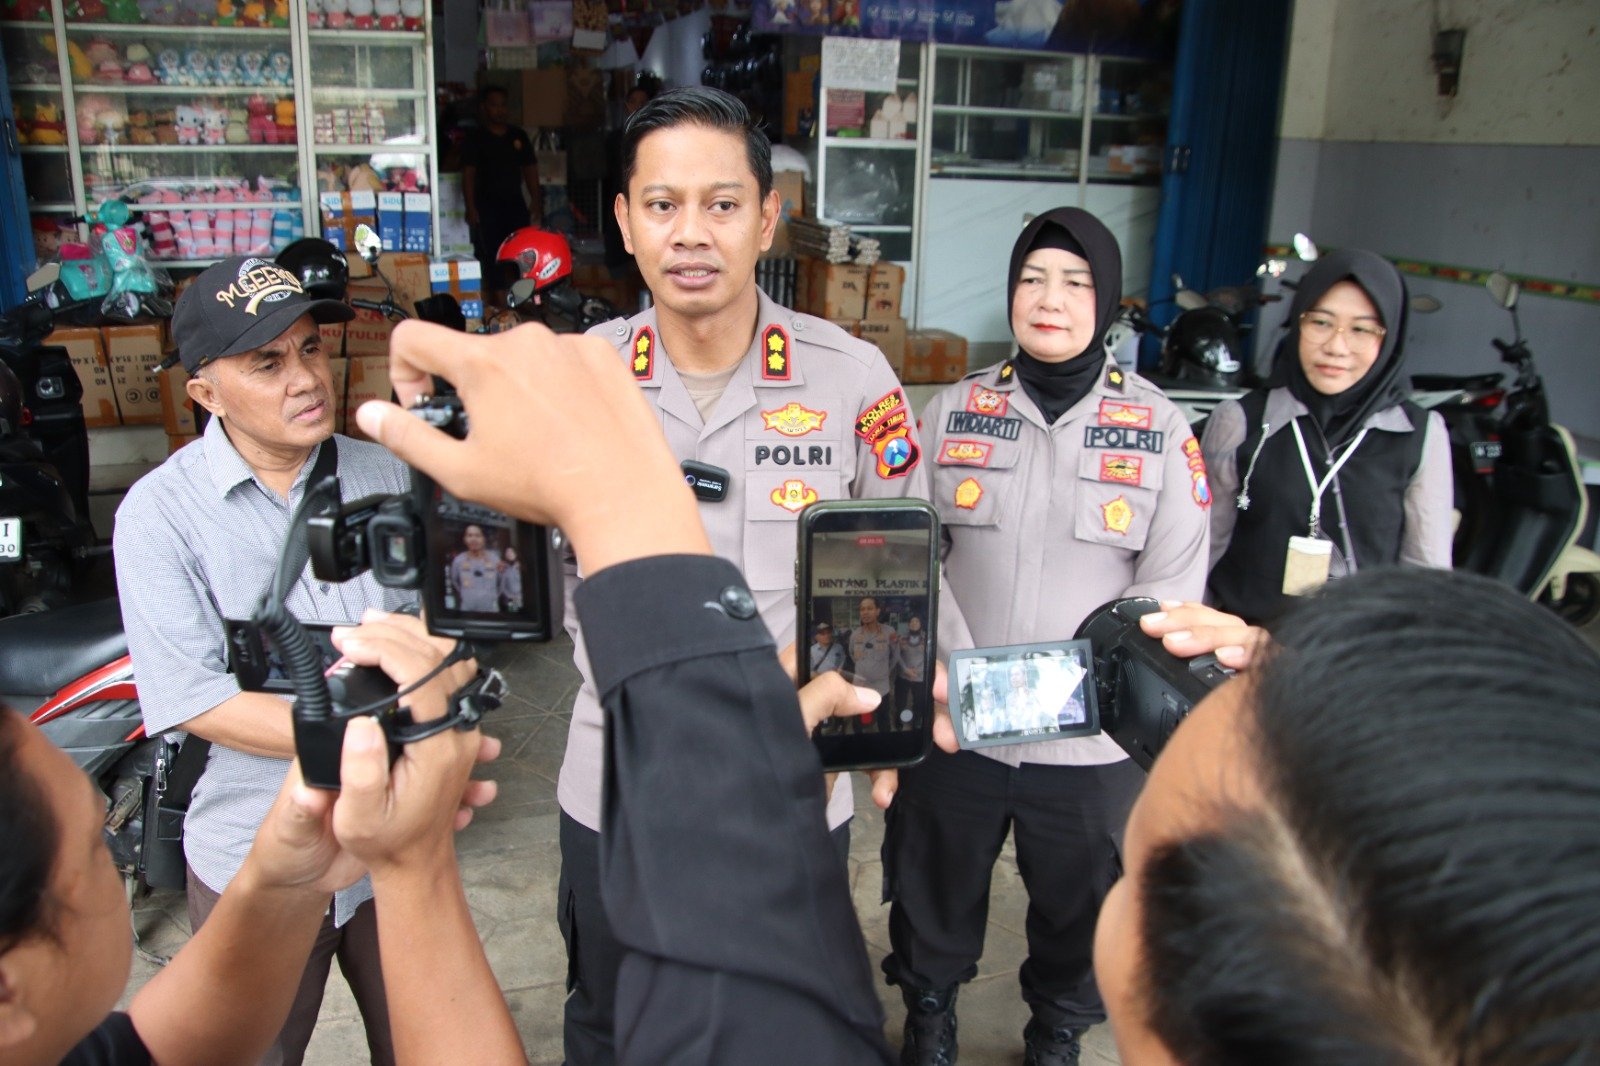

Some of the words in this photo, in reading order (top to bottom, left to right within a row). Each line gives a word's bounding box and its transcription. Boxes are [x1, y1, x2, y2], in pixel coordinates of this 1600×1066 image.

[348, 330, 387, 340] TULIS
[860, 394, 896, 425] POLRES
[1090, 429, 1158, 452] POLRI
[755, 445, 832, 466] POLRI
[875, 579, 919, 588] PLASTIK
